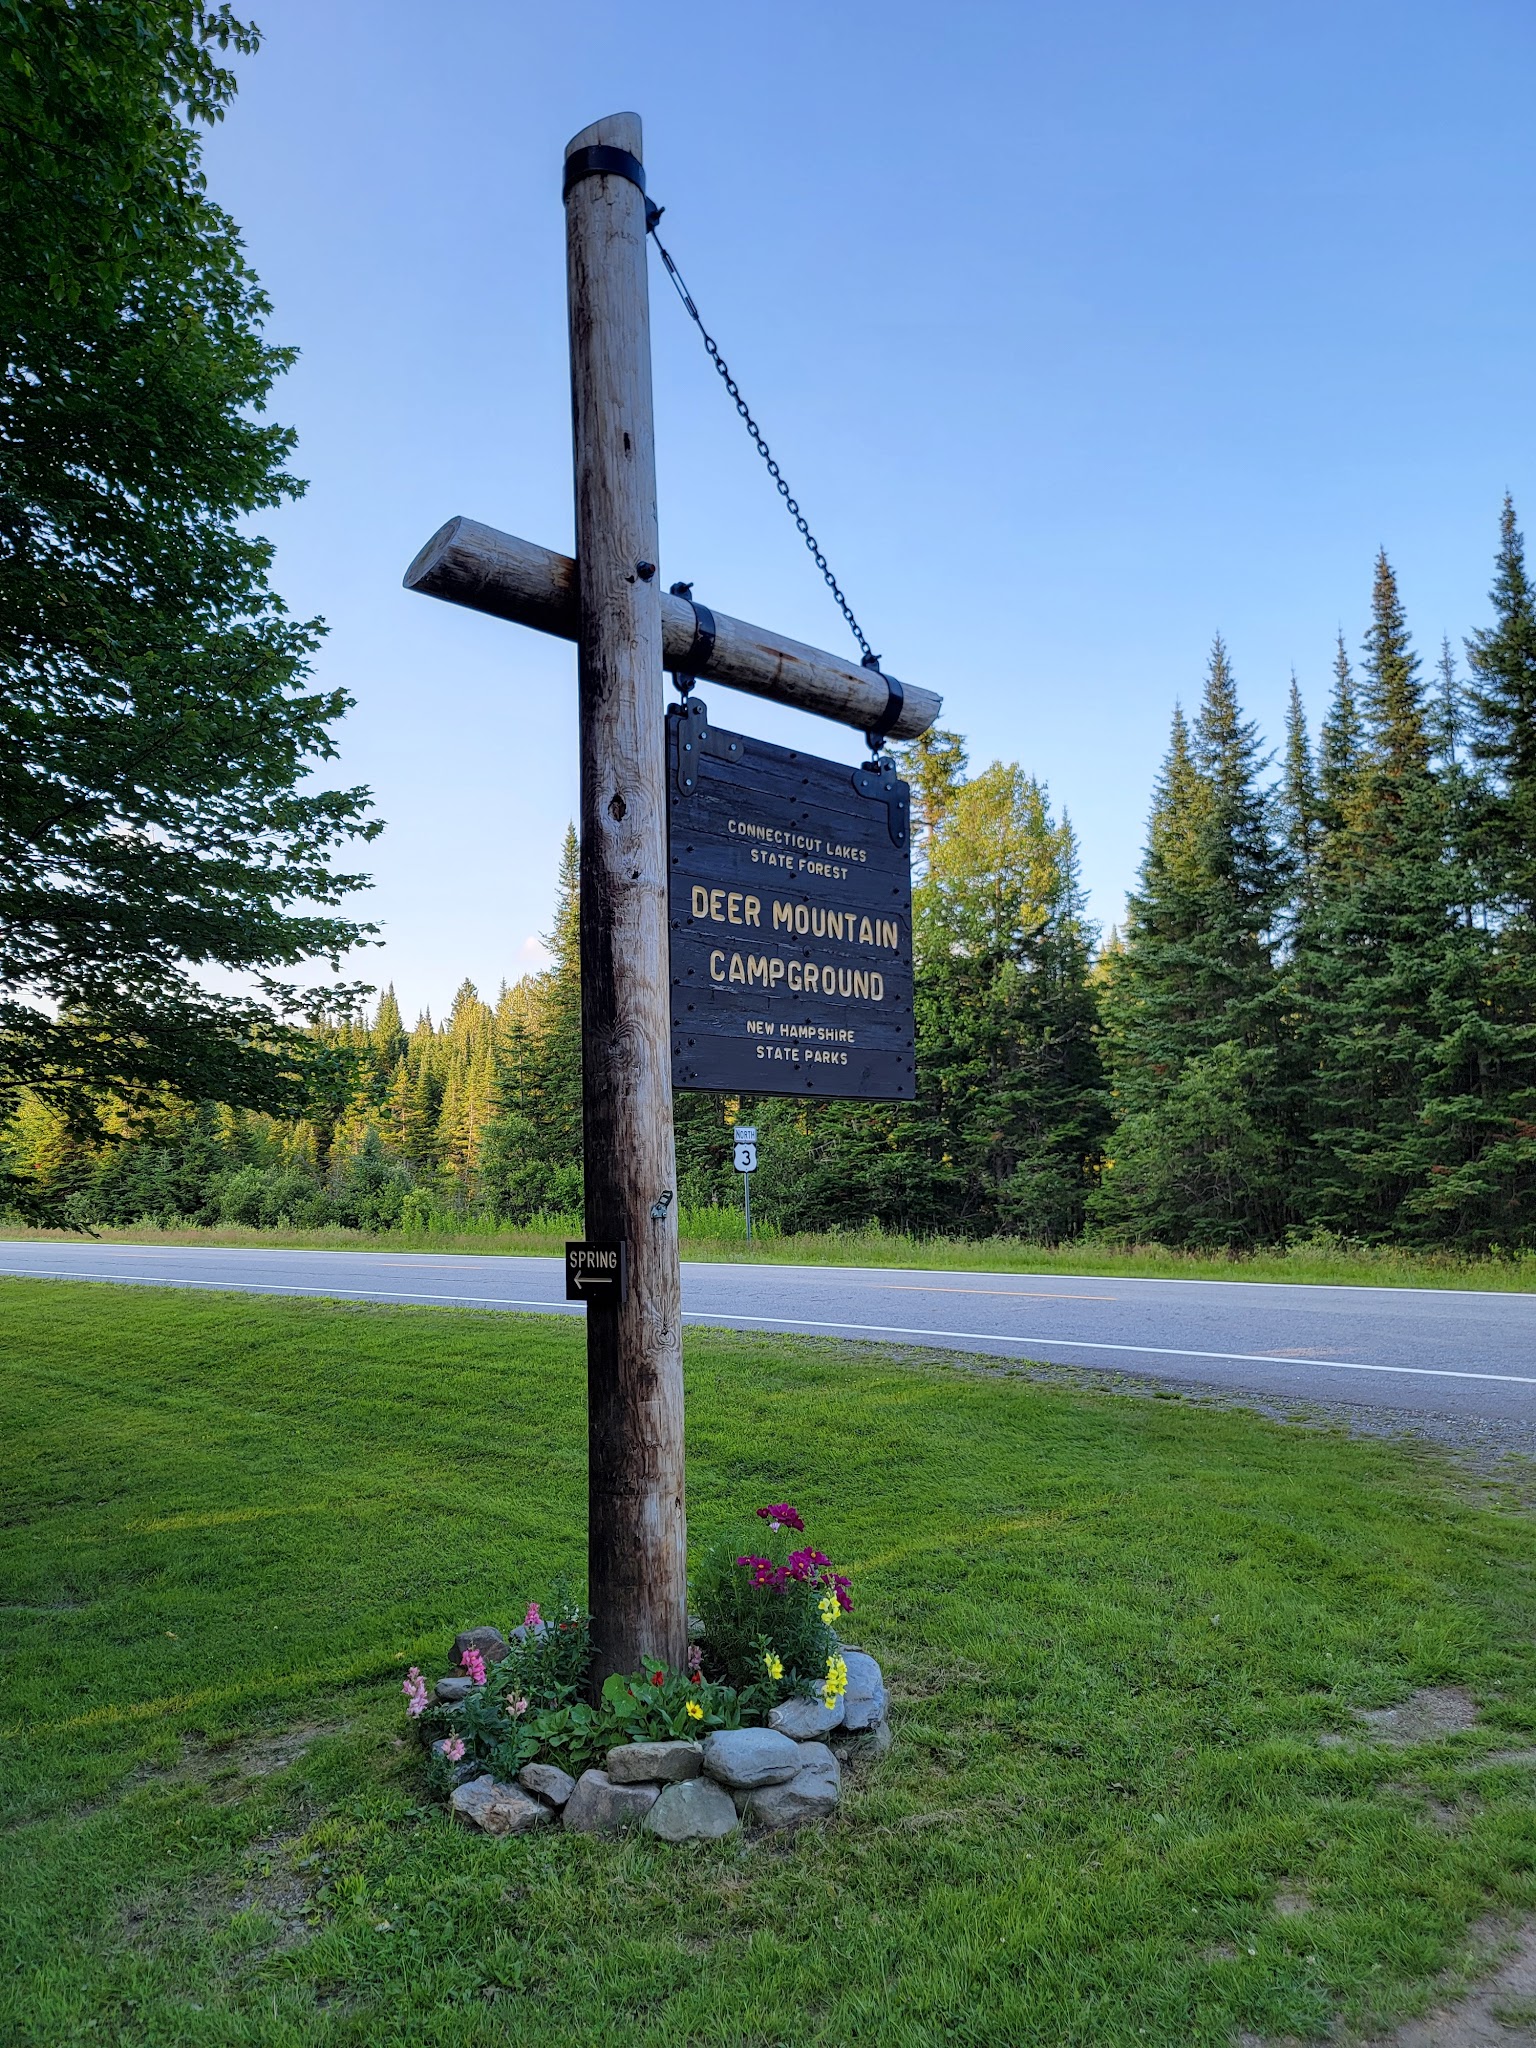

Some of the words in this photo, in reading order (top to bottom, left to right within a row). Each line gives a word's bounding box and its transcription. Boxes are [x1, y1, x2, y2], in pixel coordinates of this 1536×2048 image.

[728, 819, 822, 853] CONNECTICUT
[826, 842, 867, 863] LAKES
[750, 849, 794, 870] STATE
[798, 858, 849, 880] FOREST
[691, 884, 761, 928] DEER
[772, 899, 899, 950] MOUNTAIN
[709, 949, 884, 1002] CAMPGROUND
[747, 1020, 775, 1036] NEW
[780, 1023, 856, 1043] HAMPSHIRE
[756, 1045, 800, 1062] STATE
[805, 1049, 849, 1066] PARKS
[736, 1130, 755, 1139] NORTH
[742, 1150, 751, 1166] 3
[570, 1250, 617, 1268] SPRING
